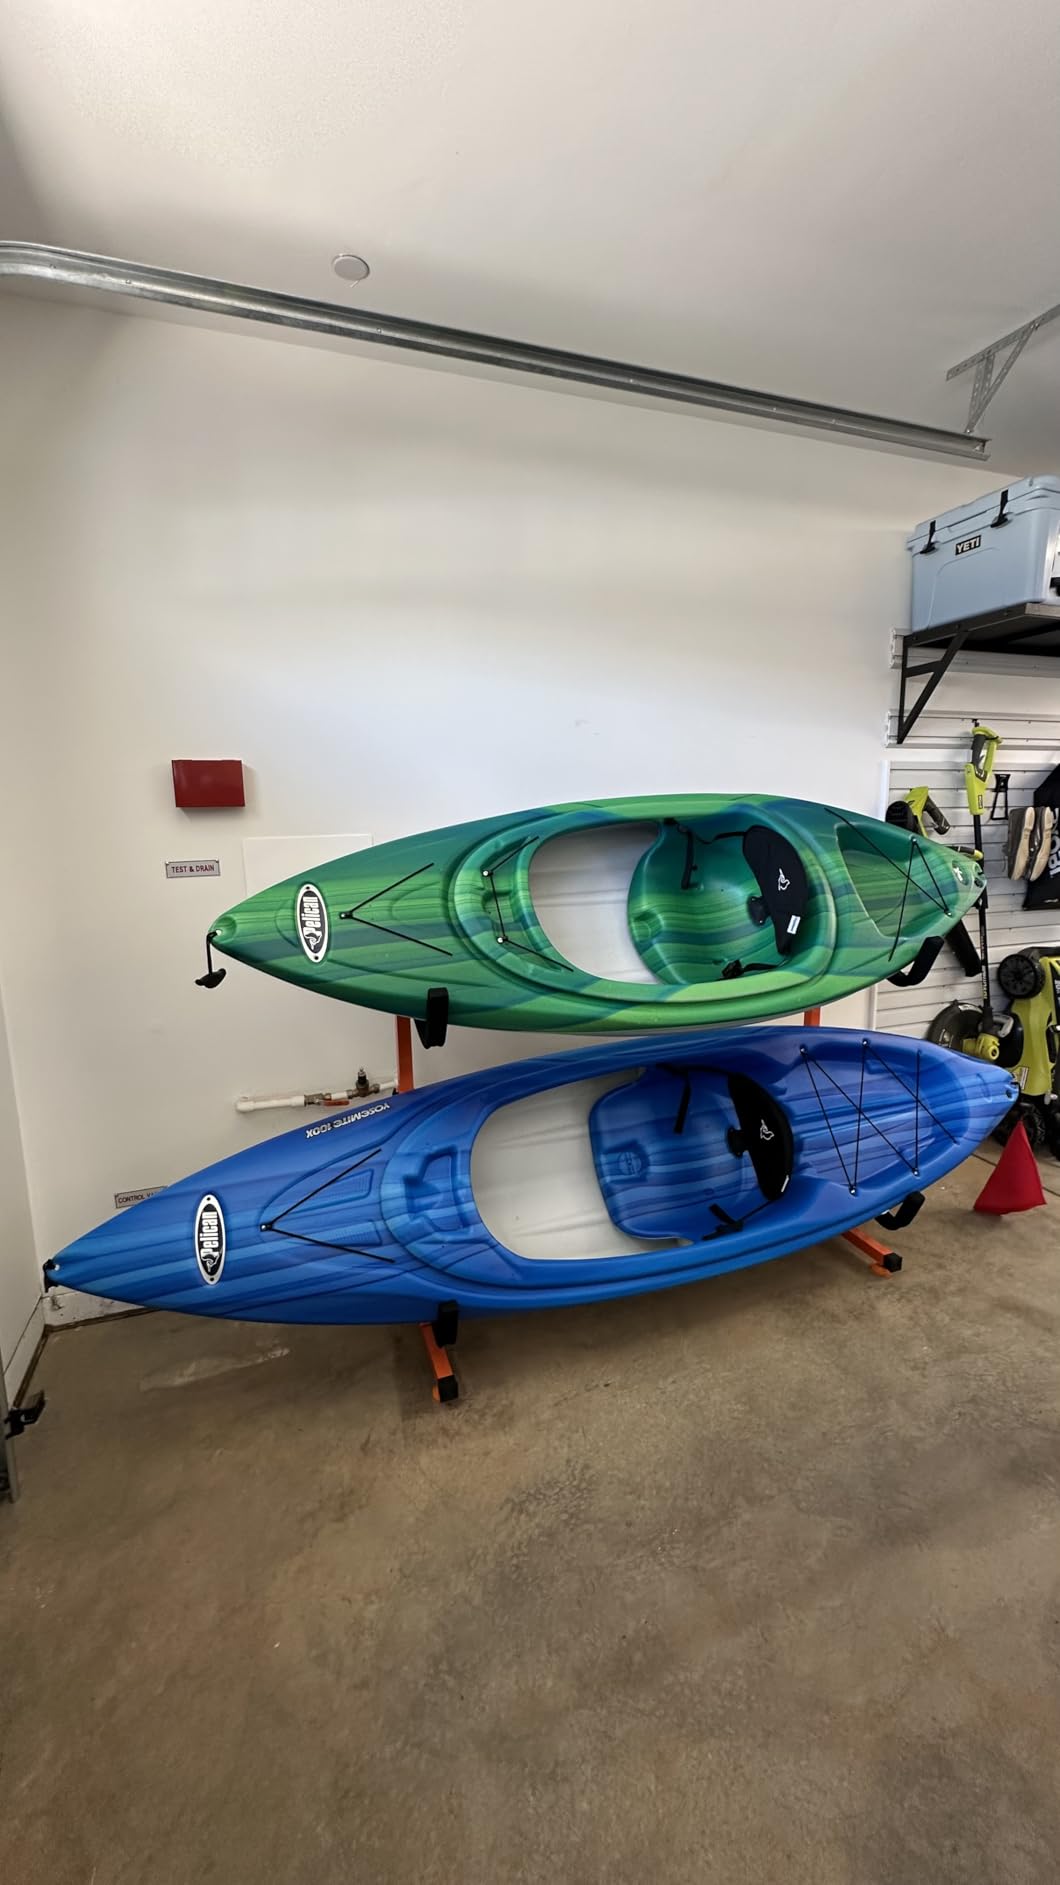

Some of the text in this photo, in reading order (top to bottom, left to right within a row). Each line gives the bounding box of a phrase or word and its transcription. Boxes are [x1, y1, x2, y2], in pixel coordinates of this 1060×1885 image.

[957, 536, 980, 553] YETI
[171, 865, 187, 873] TEST
[196, 864, 215, 872] DRAIN
[301, 896, 323, 940] Pelican
[306, 1122, 332, 1138] 100X
[118, 1194, 145, 1204] CONTROL
[199, 1211, 219, 1260] Pelican
